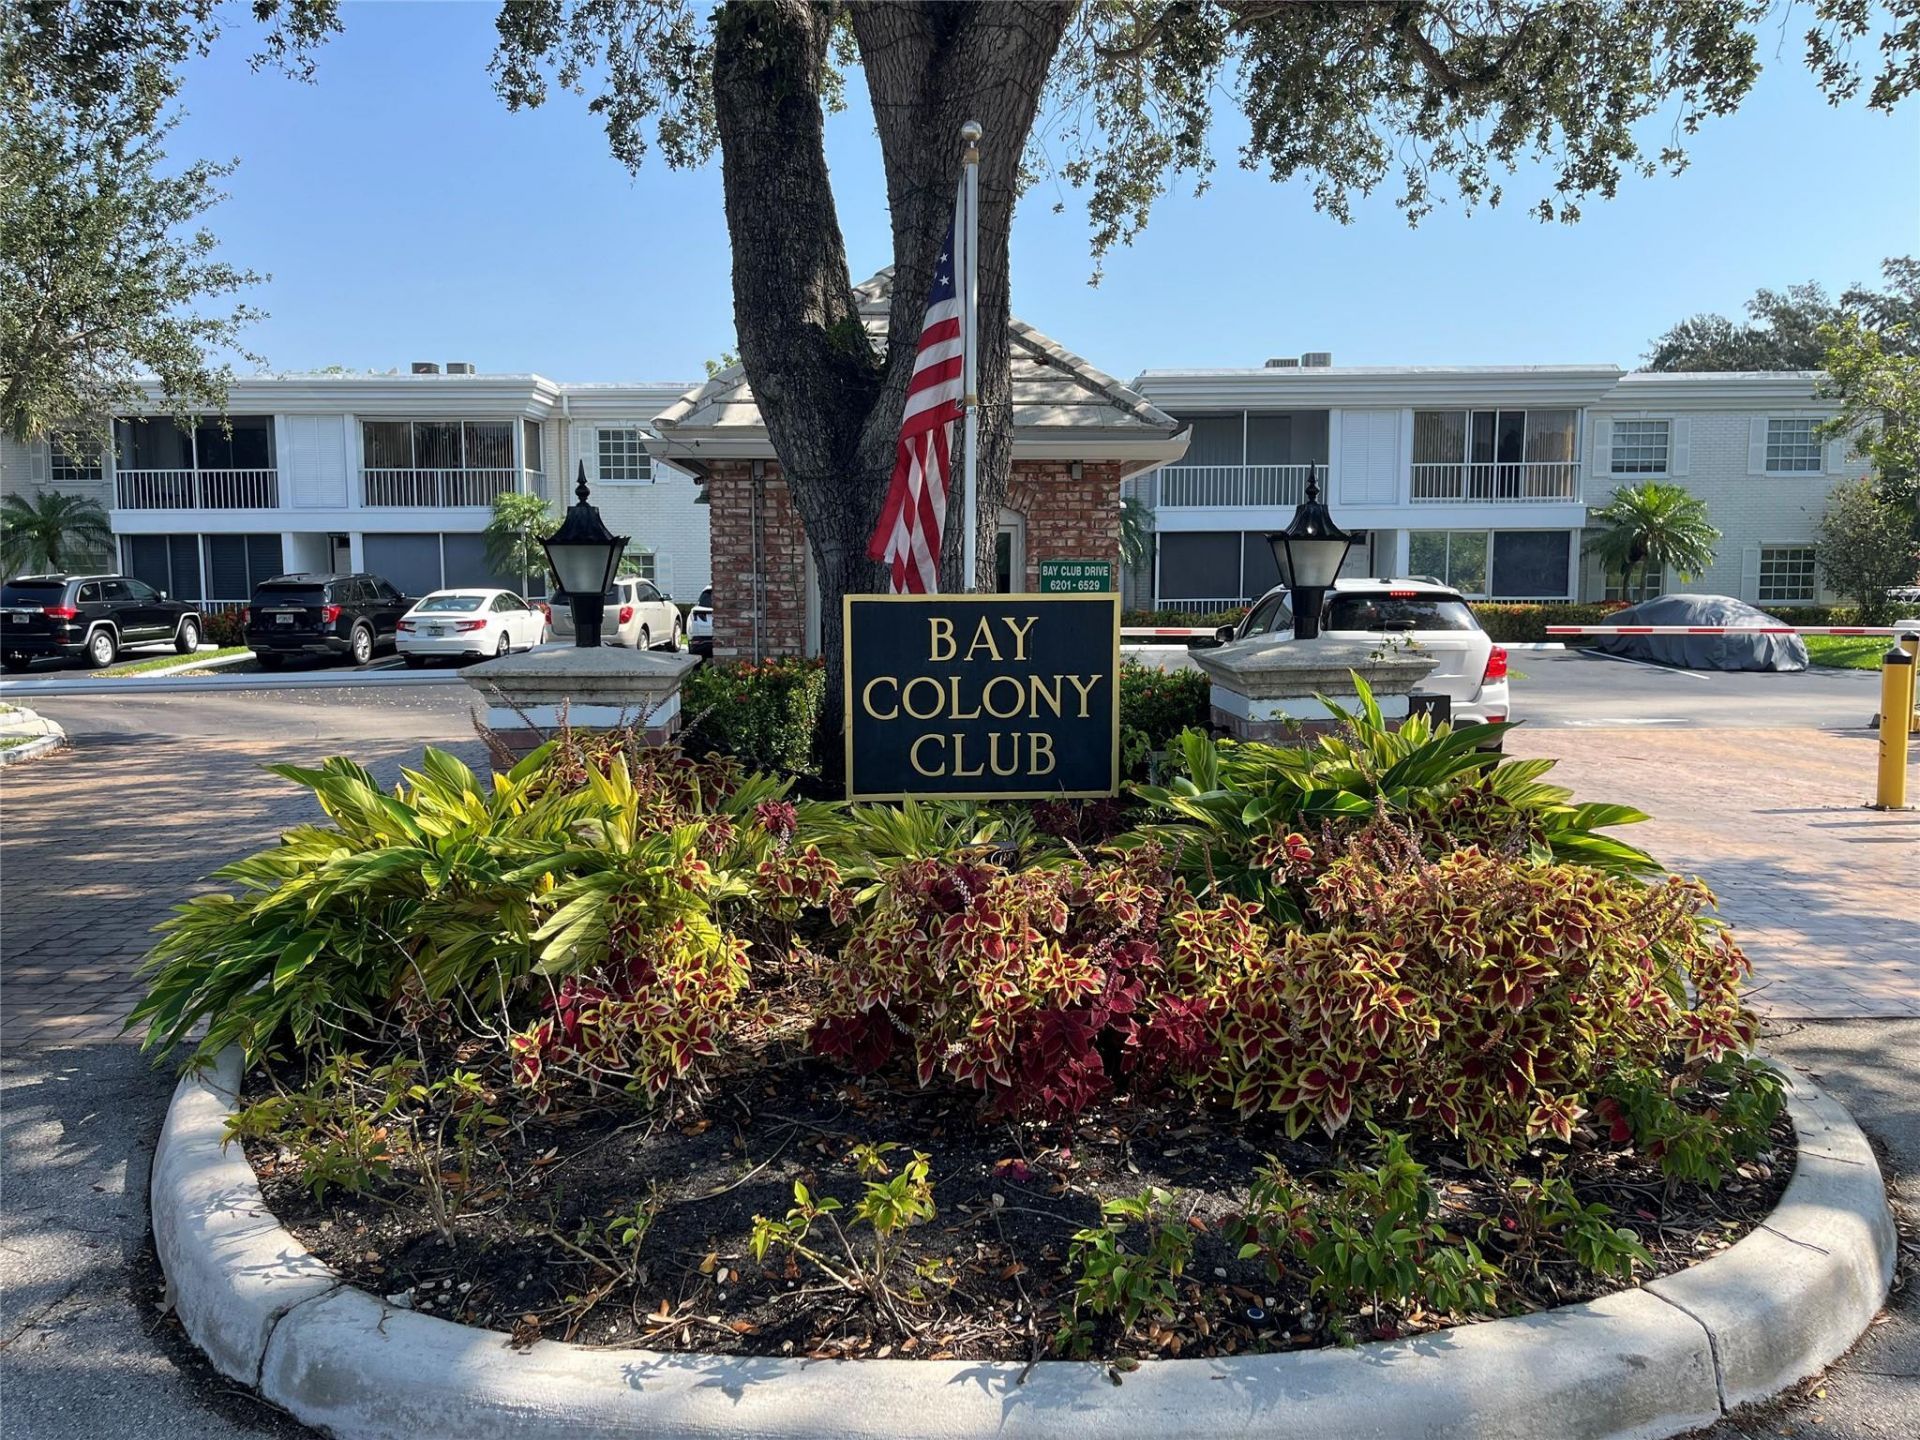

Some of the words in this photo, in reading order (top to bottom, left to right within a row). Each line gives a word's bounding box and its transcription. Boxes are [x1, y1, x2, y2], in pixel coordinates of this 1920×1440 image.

[1042, 566, 1059, 576] BAY
[1061, 566, 1082, 576] CLUB
[1084, 566, 1108, 576] DRIVE
[927, 615, 1039, 661] BAY
[862, 674, 1103, 720] COLONY
[910, 732, 1056, 777] CLUB
